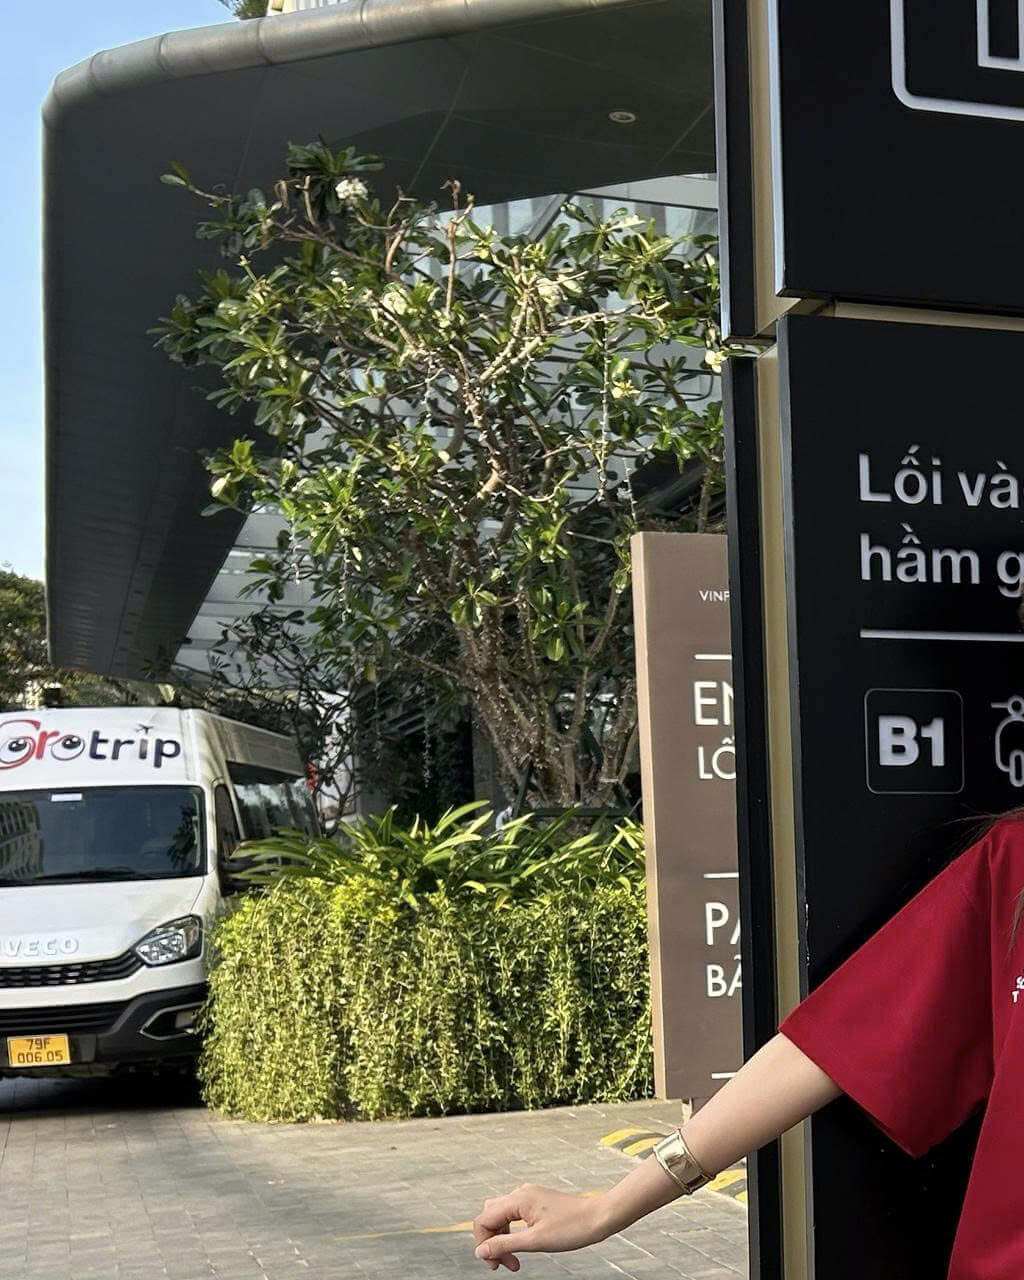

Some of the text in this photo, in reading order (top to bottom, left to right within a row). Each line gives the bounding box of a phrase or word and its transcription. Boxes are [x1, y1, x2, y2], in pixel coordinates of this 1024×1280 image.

[859, 444, 943, 505] Lối
[860, 522, 981, 584] hầm
[878, 714, 945, 767] B1
